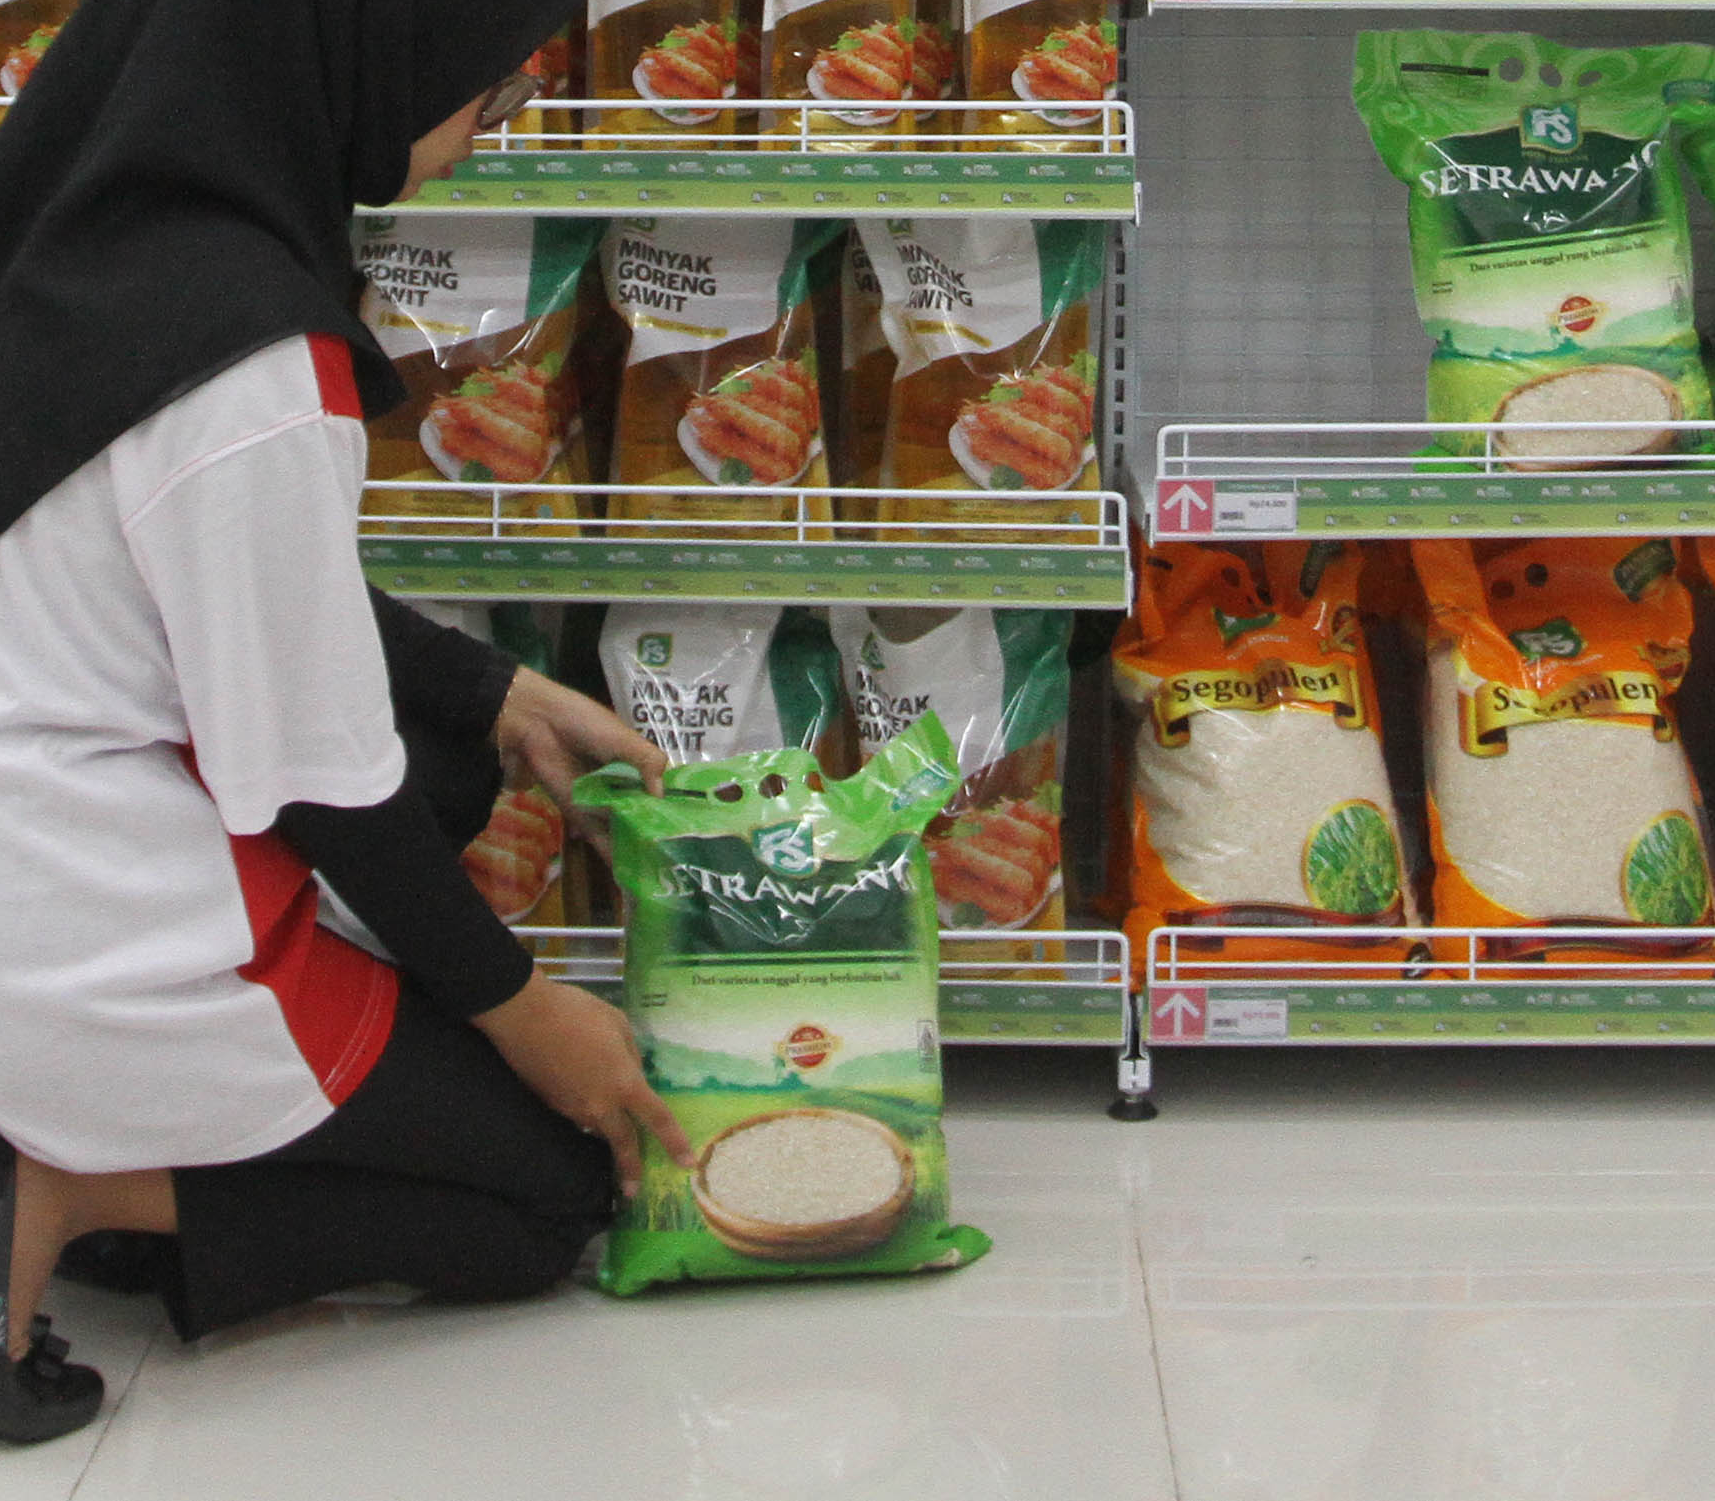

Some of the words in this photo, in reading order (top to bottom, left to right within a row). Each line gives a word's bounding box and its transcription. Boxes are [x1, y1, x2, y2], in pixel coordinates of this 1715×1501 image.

[618, 237, 714, 275] MINYAK
[618, 260, 718, 297] GORENG
[617, 283, 688, 315] SAWIT
